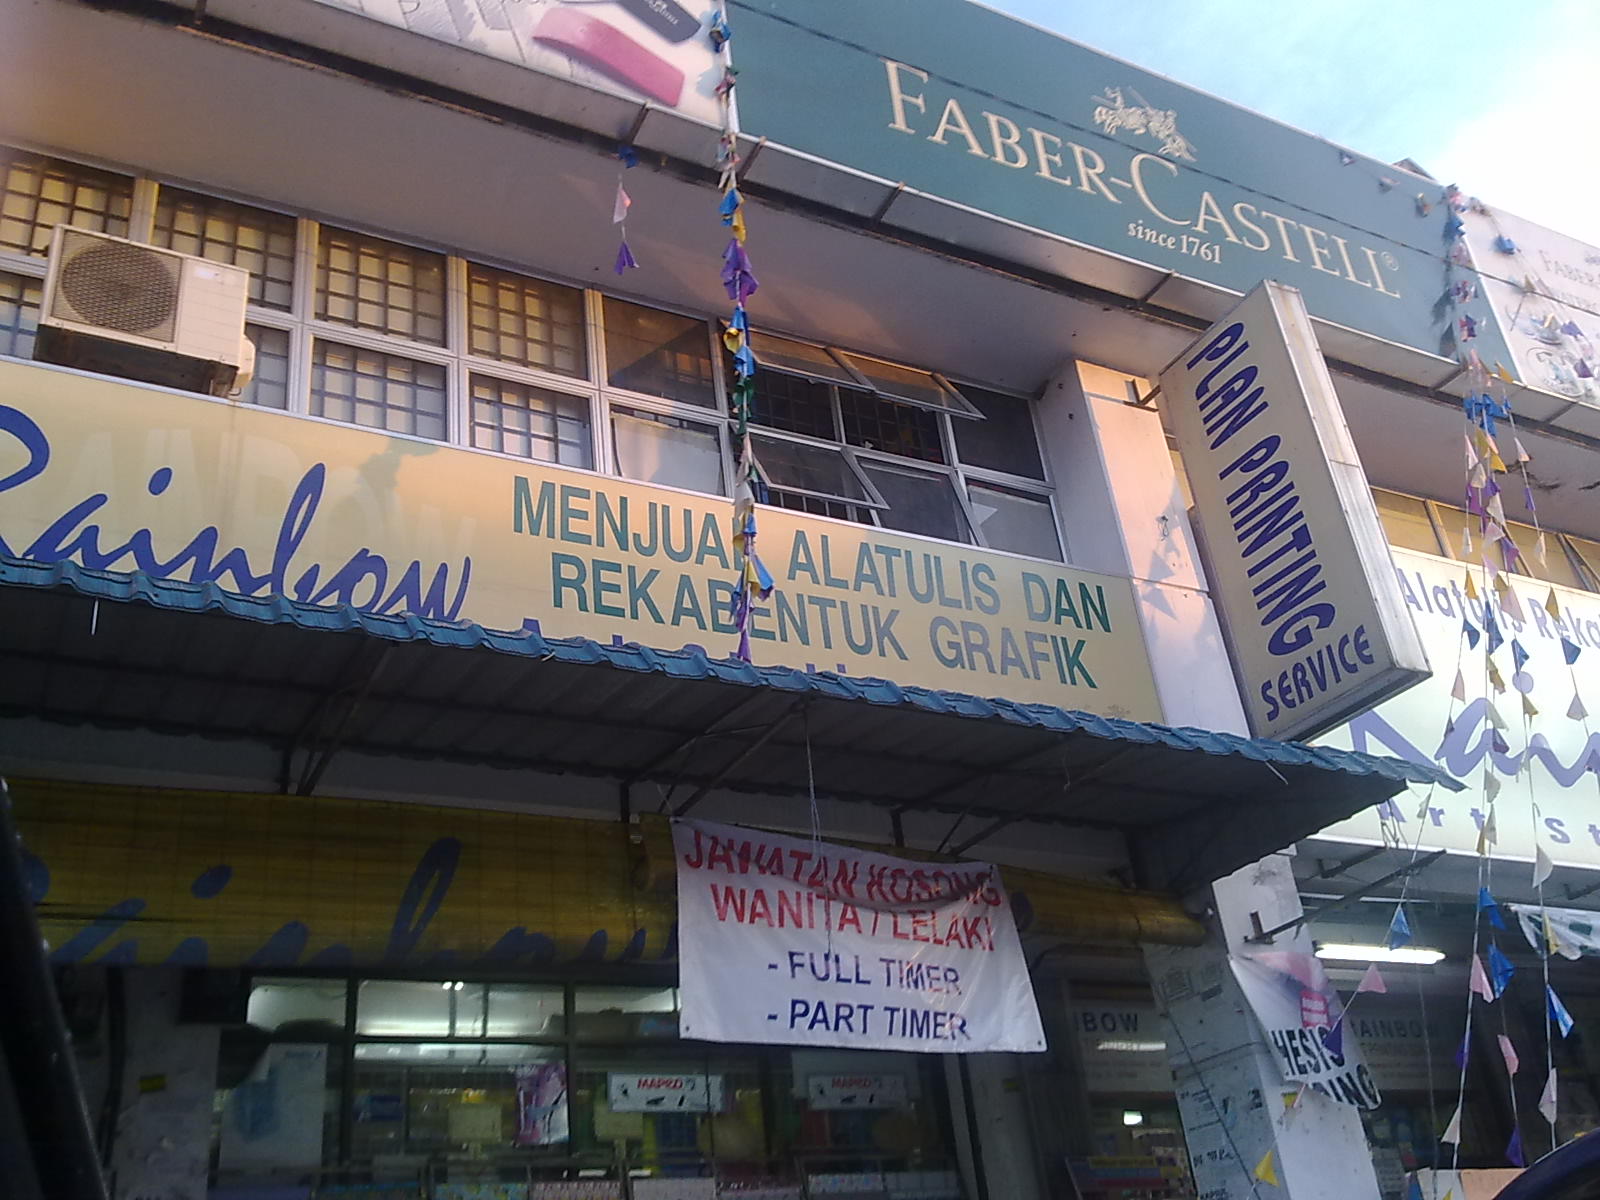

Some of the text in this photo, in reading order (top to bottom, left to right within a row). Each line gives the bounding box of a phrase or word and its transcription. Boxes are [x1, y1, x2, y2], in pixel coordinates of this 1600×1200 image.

[1128, 220, 1222, 264] since 1761
[1186, 322, 1336, 657] PLAN PRINTING
[513, 475, 1112, 633] MENJUA ALATULIS DAN
[551, 552, 909, 661] REKABENTUK
[929, 616, 1098, 689] GRAFIK
[1260, 624, 1375, 723] SERVICE
[685, 829, 1001, 907] JAWATAN KOSONG
[710, 883, 862, 934] WANITA
[891, 908, 994, 951] LELAKI
[788, 951, 871, 985] FULL
[879, 957, 962, 996] TIMER
[789, 998, 875, 1035] PART
[884, 1006, 971, 1041] TIMER
